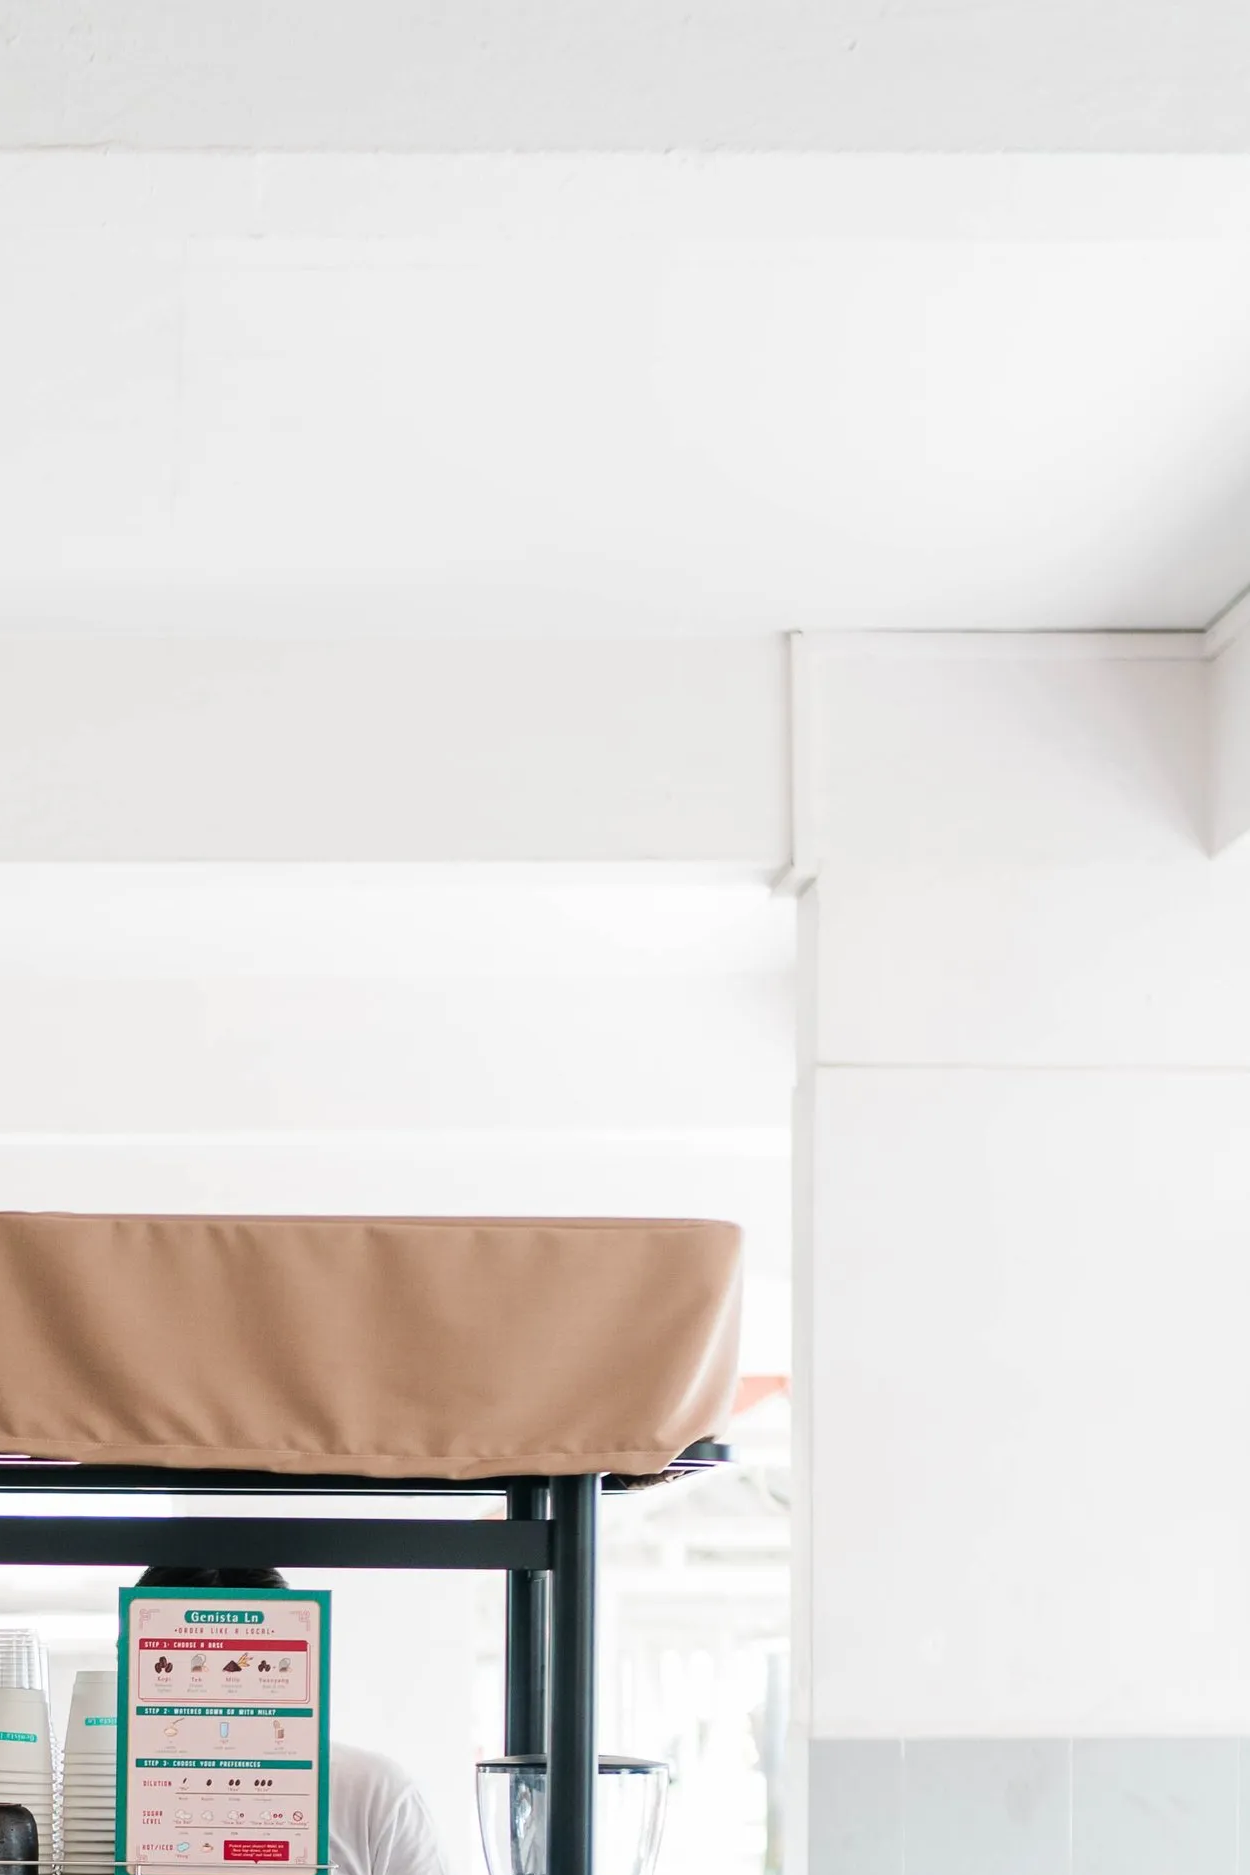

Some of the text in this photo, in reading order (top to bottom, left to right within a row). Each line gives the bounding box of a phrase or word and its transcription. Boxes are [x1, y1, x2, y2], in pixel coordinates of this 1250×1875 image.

[190, 1612, 259, 1624] Genista Ln
[173, 1708, 202, 1716] WATERED
[172, 1760, 196, 1768] CHOOSE
